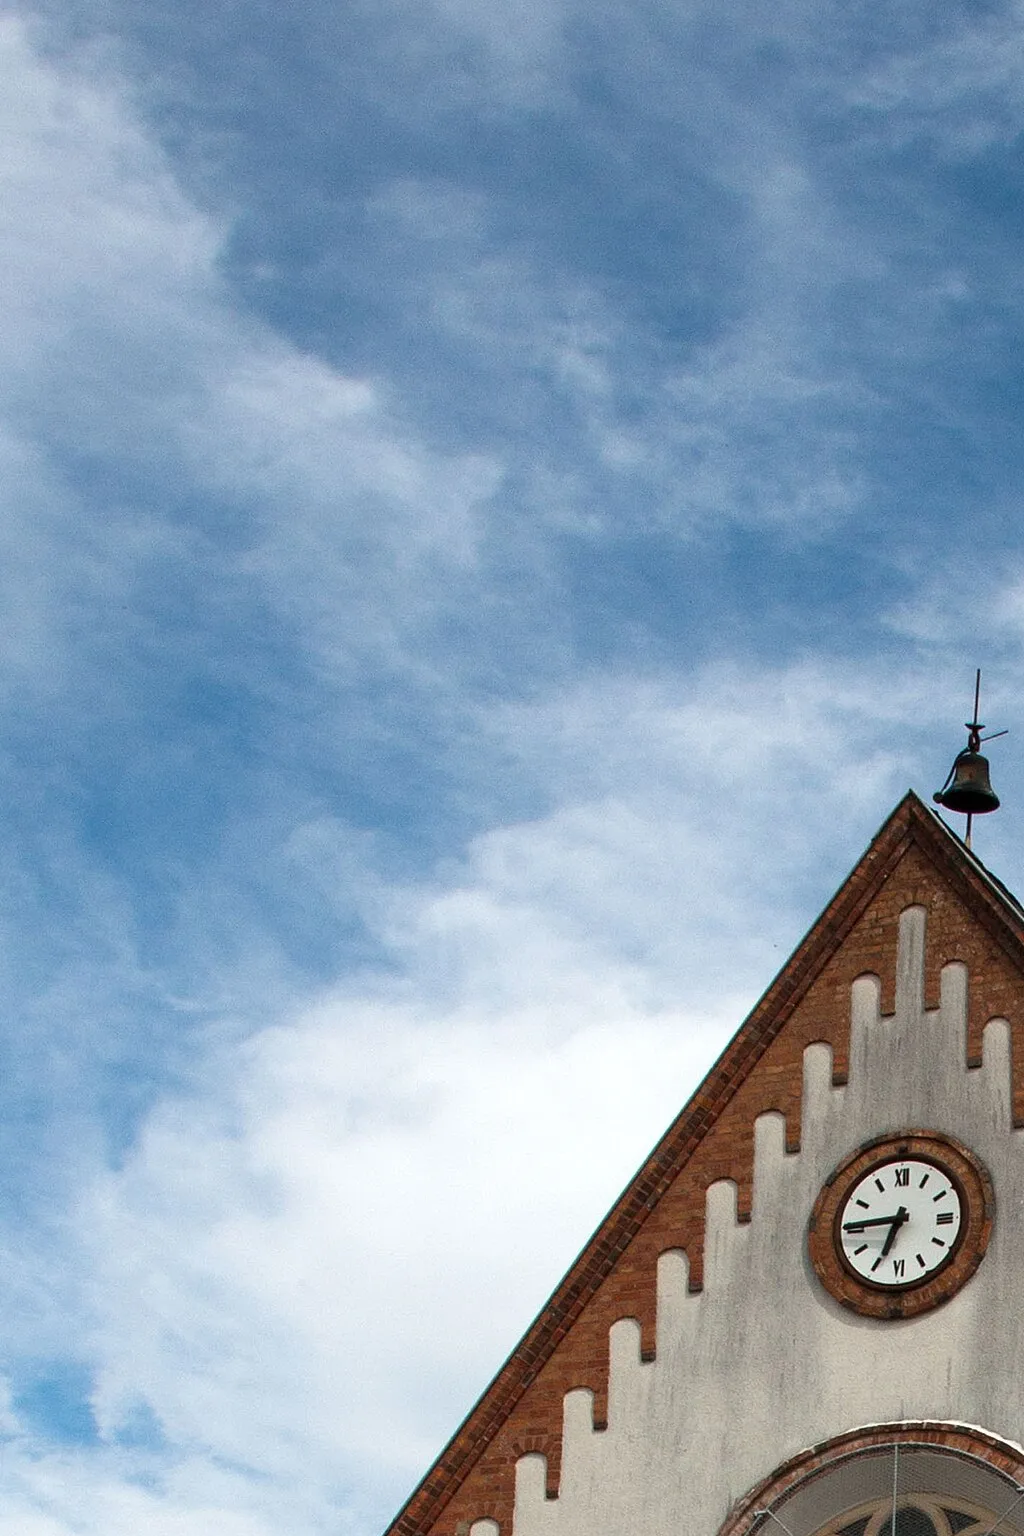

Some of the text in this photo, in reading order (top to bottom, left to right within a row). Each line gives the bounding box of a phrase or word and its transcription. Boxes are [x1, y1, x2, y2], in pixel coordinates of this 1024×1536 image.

[895, 1168, 909, 1187] XII
[936, 1212, 953, 1225] III
[893, 1259, 905, 1277] VI
